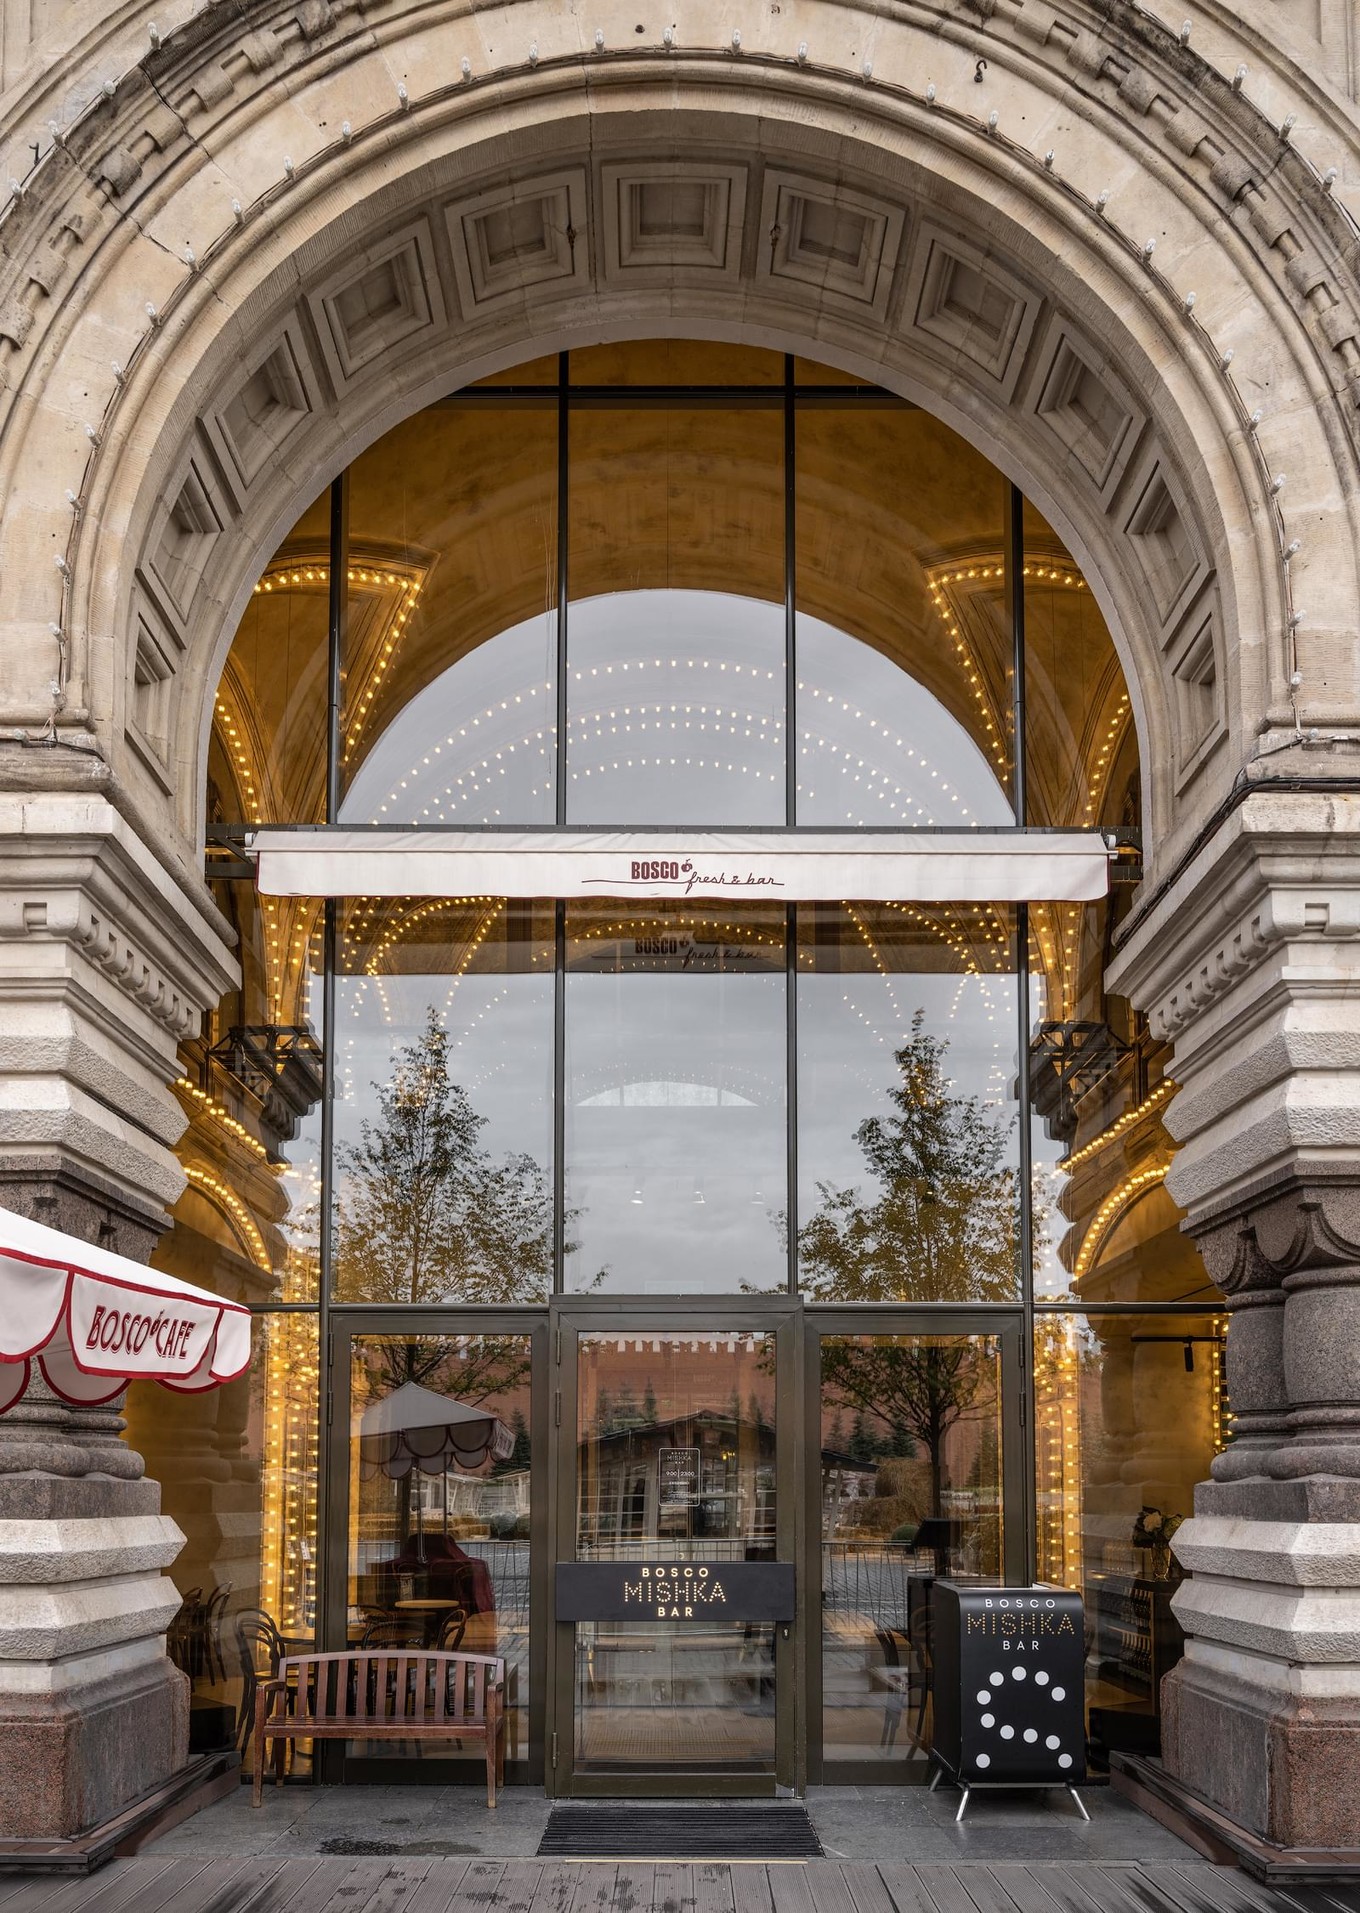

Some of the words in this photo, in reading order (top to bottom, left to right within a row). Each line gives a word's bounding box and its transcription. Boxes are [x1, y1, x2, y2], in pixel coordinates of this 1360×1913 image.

[631, 861, 679, 880] BOSCO
[685, 871, 725, 894] fresh
[731, 875, 741, 885] &
[747, 872, 780, 885] bar
[86, 1305, 153, 1355] BOSCO
[155, 1318, 197, 1359] CAFE
[641, 1567, 709, 1578] BOSCO
[624, 1581, 727, 1603] MISHKA
[657, 1606, 693, 1617] BAR
[984, 1598, 1056, 1609] BOSCO
[967, 1613, 1075, 1635] MISHKA
[1002, 1640, 1040, 1651] BAR
